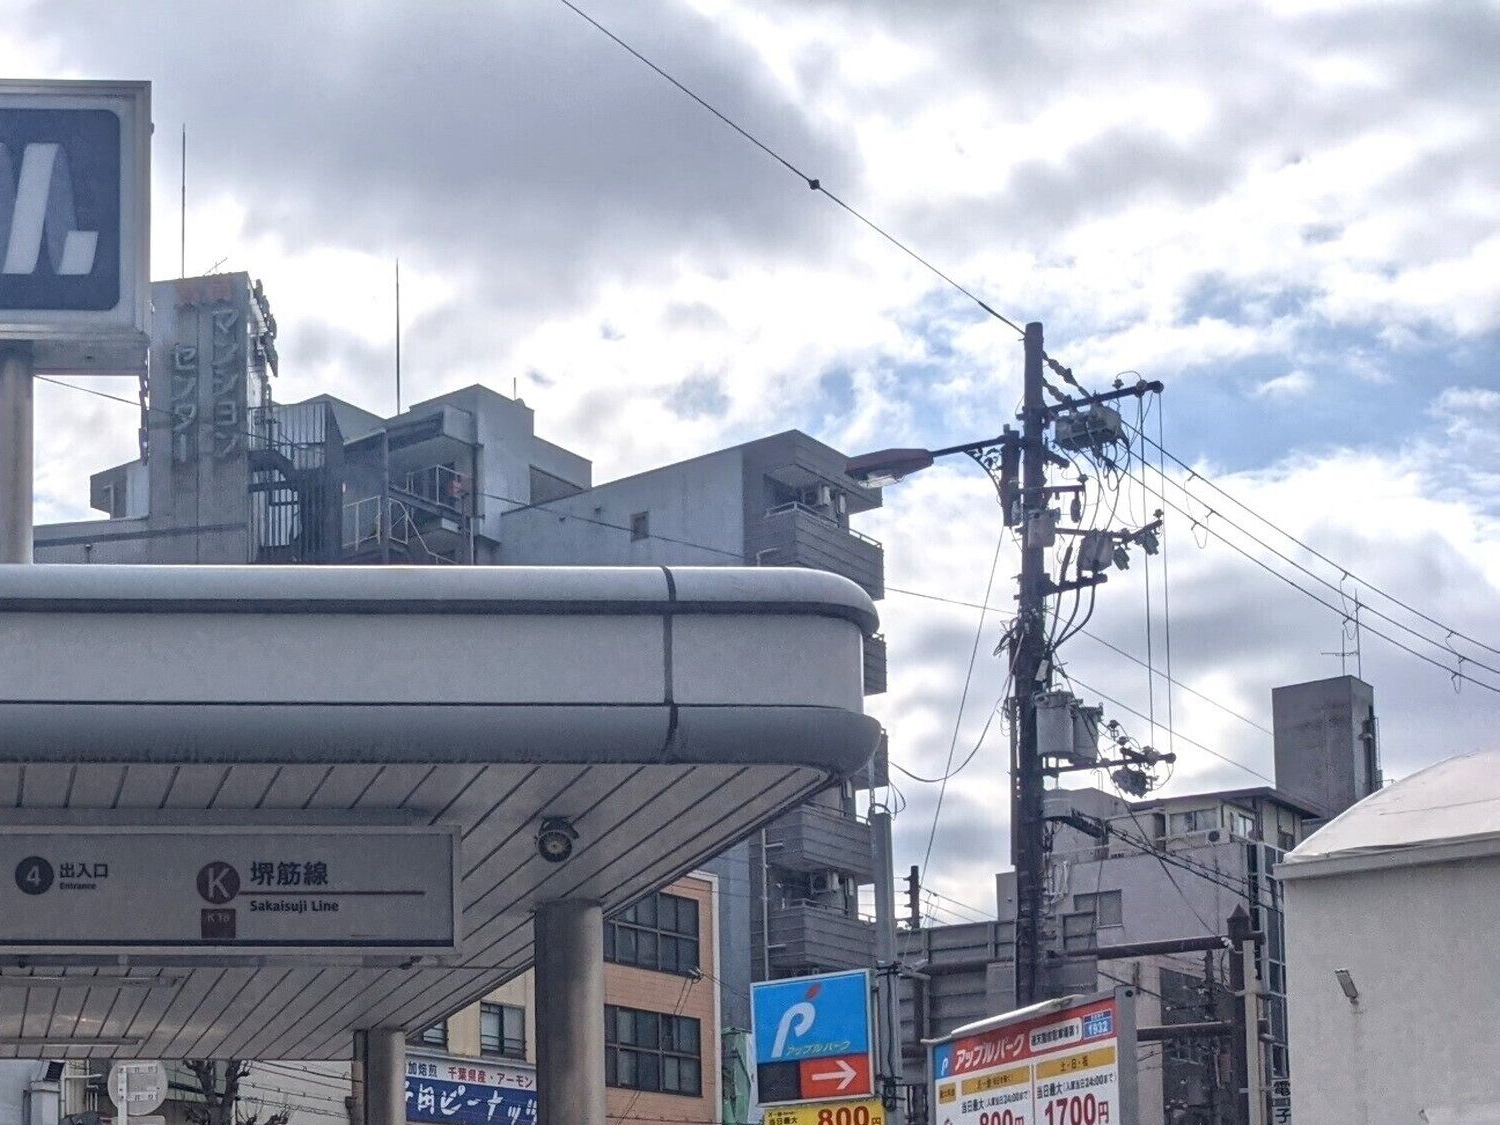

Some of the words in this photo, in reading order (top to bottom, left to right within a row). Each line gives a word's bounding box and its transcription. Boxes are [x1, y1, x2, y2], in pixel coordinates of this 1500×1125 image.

[166, 343, 197, 464] センター
[26, 869, 41, 886] 4
[59, 863, 108, 879] 出入口
[60, 882, 97, 890] Entrance
[209, 868, 231, 898] K
[250, 861, 329, 886] 堺筋線
[250, 900, 306, 913] Sakaisuji
[311, 900, 339, 912] Line
[955, 1034, 1025, 1072] アップルパーク
